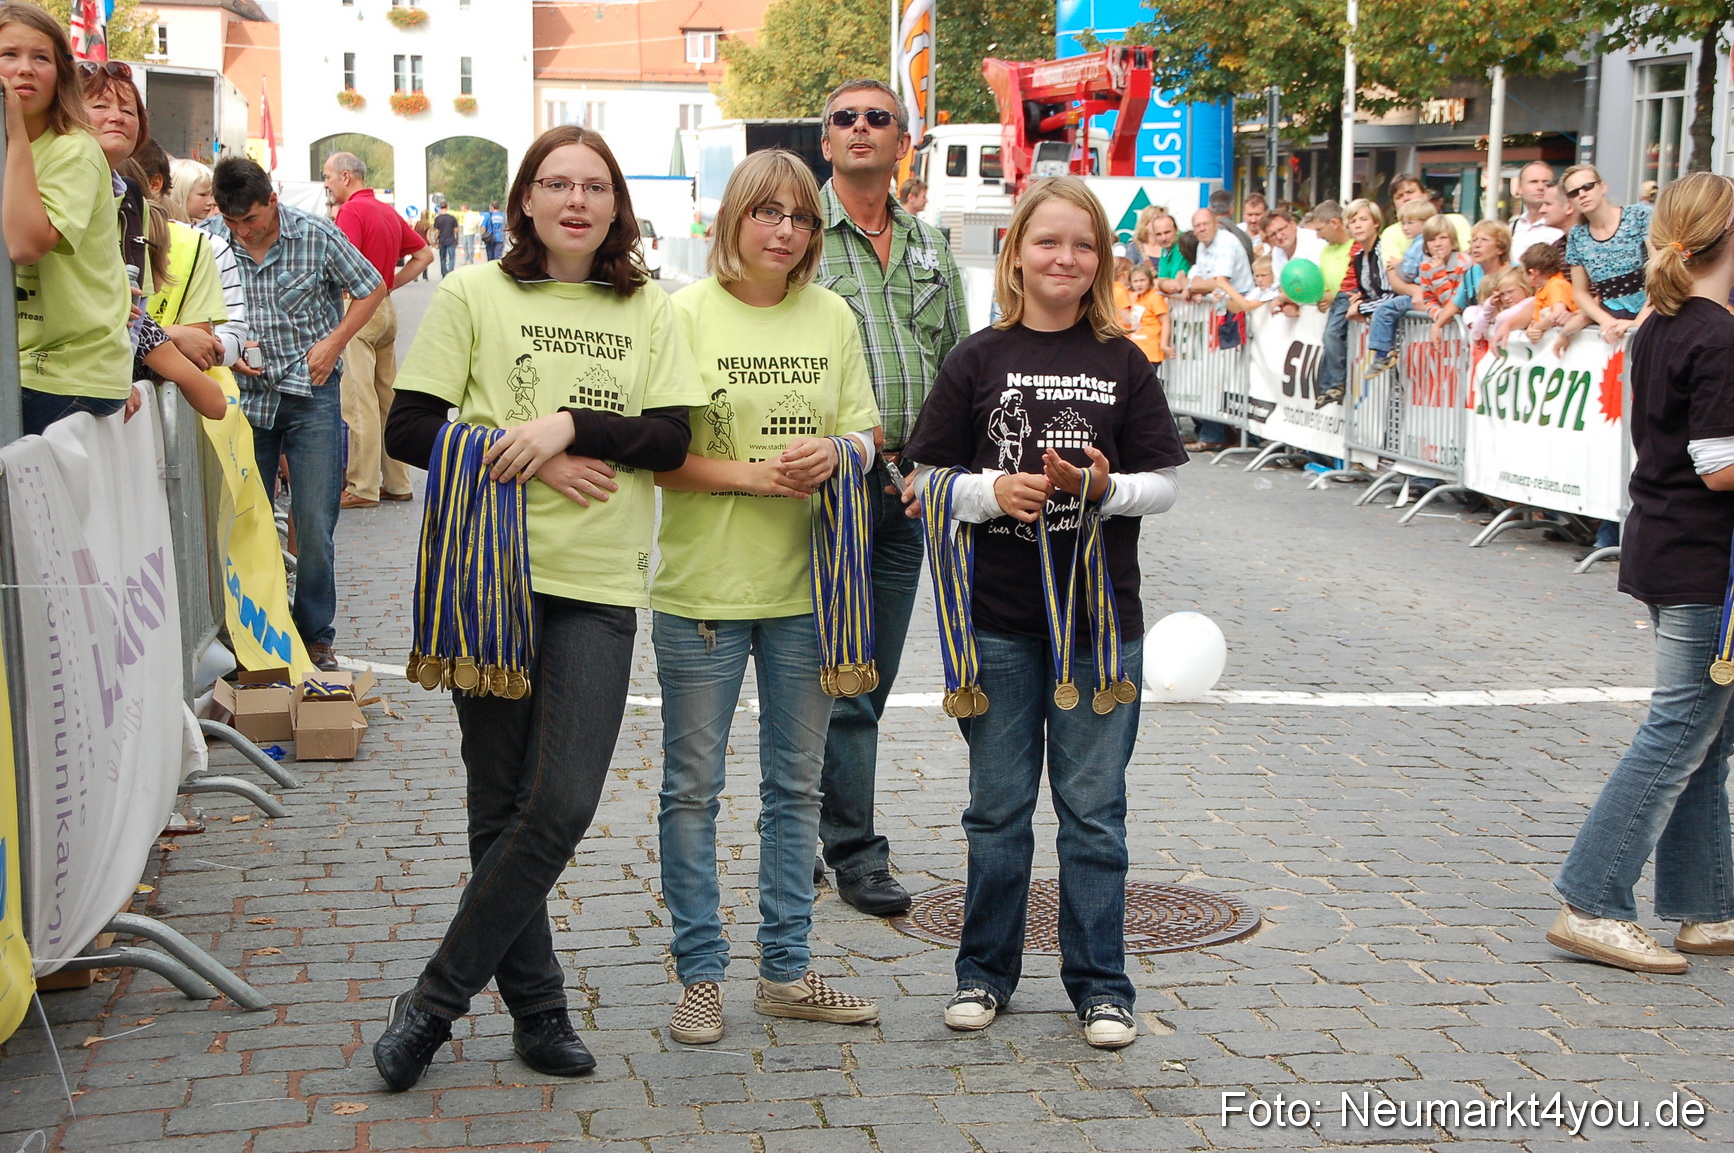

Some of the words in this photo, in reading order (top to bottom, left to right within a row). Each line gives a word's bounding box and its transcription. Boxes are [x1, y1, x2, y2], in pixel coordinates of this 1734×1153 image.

[520, 325, 633, 351] NEUMARKTER
[532, 339, 627, 361] STADTLAUF
[717, 356, 829, 371] NEUMARKTER
[728, 371, 821, 385] STADTLAUF
[1007, 372, 1117, 394] Neumarkter
[1035, 387, 1117, 406] STADTLAUF
